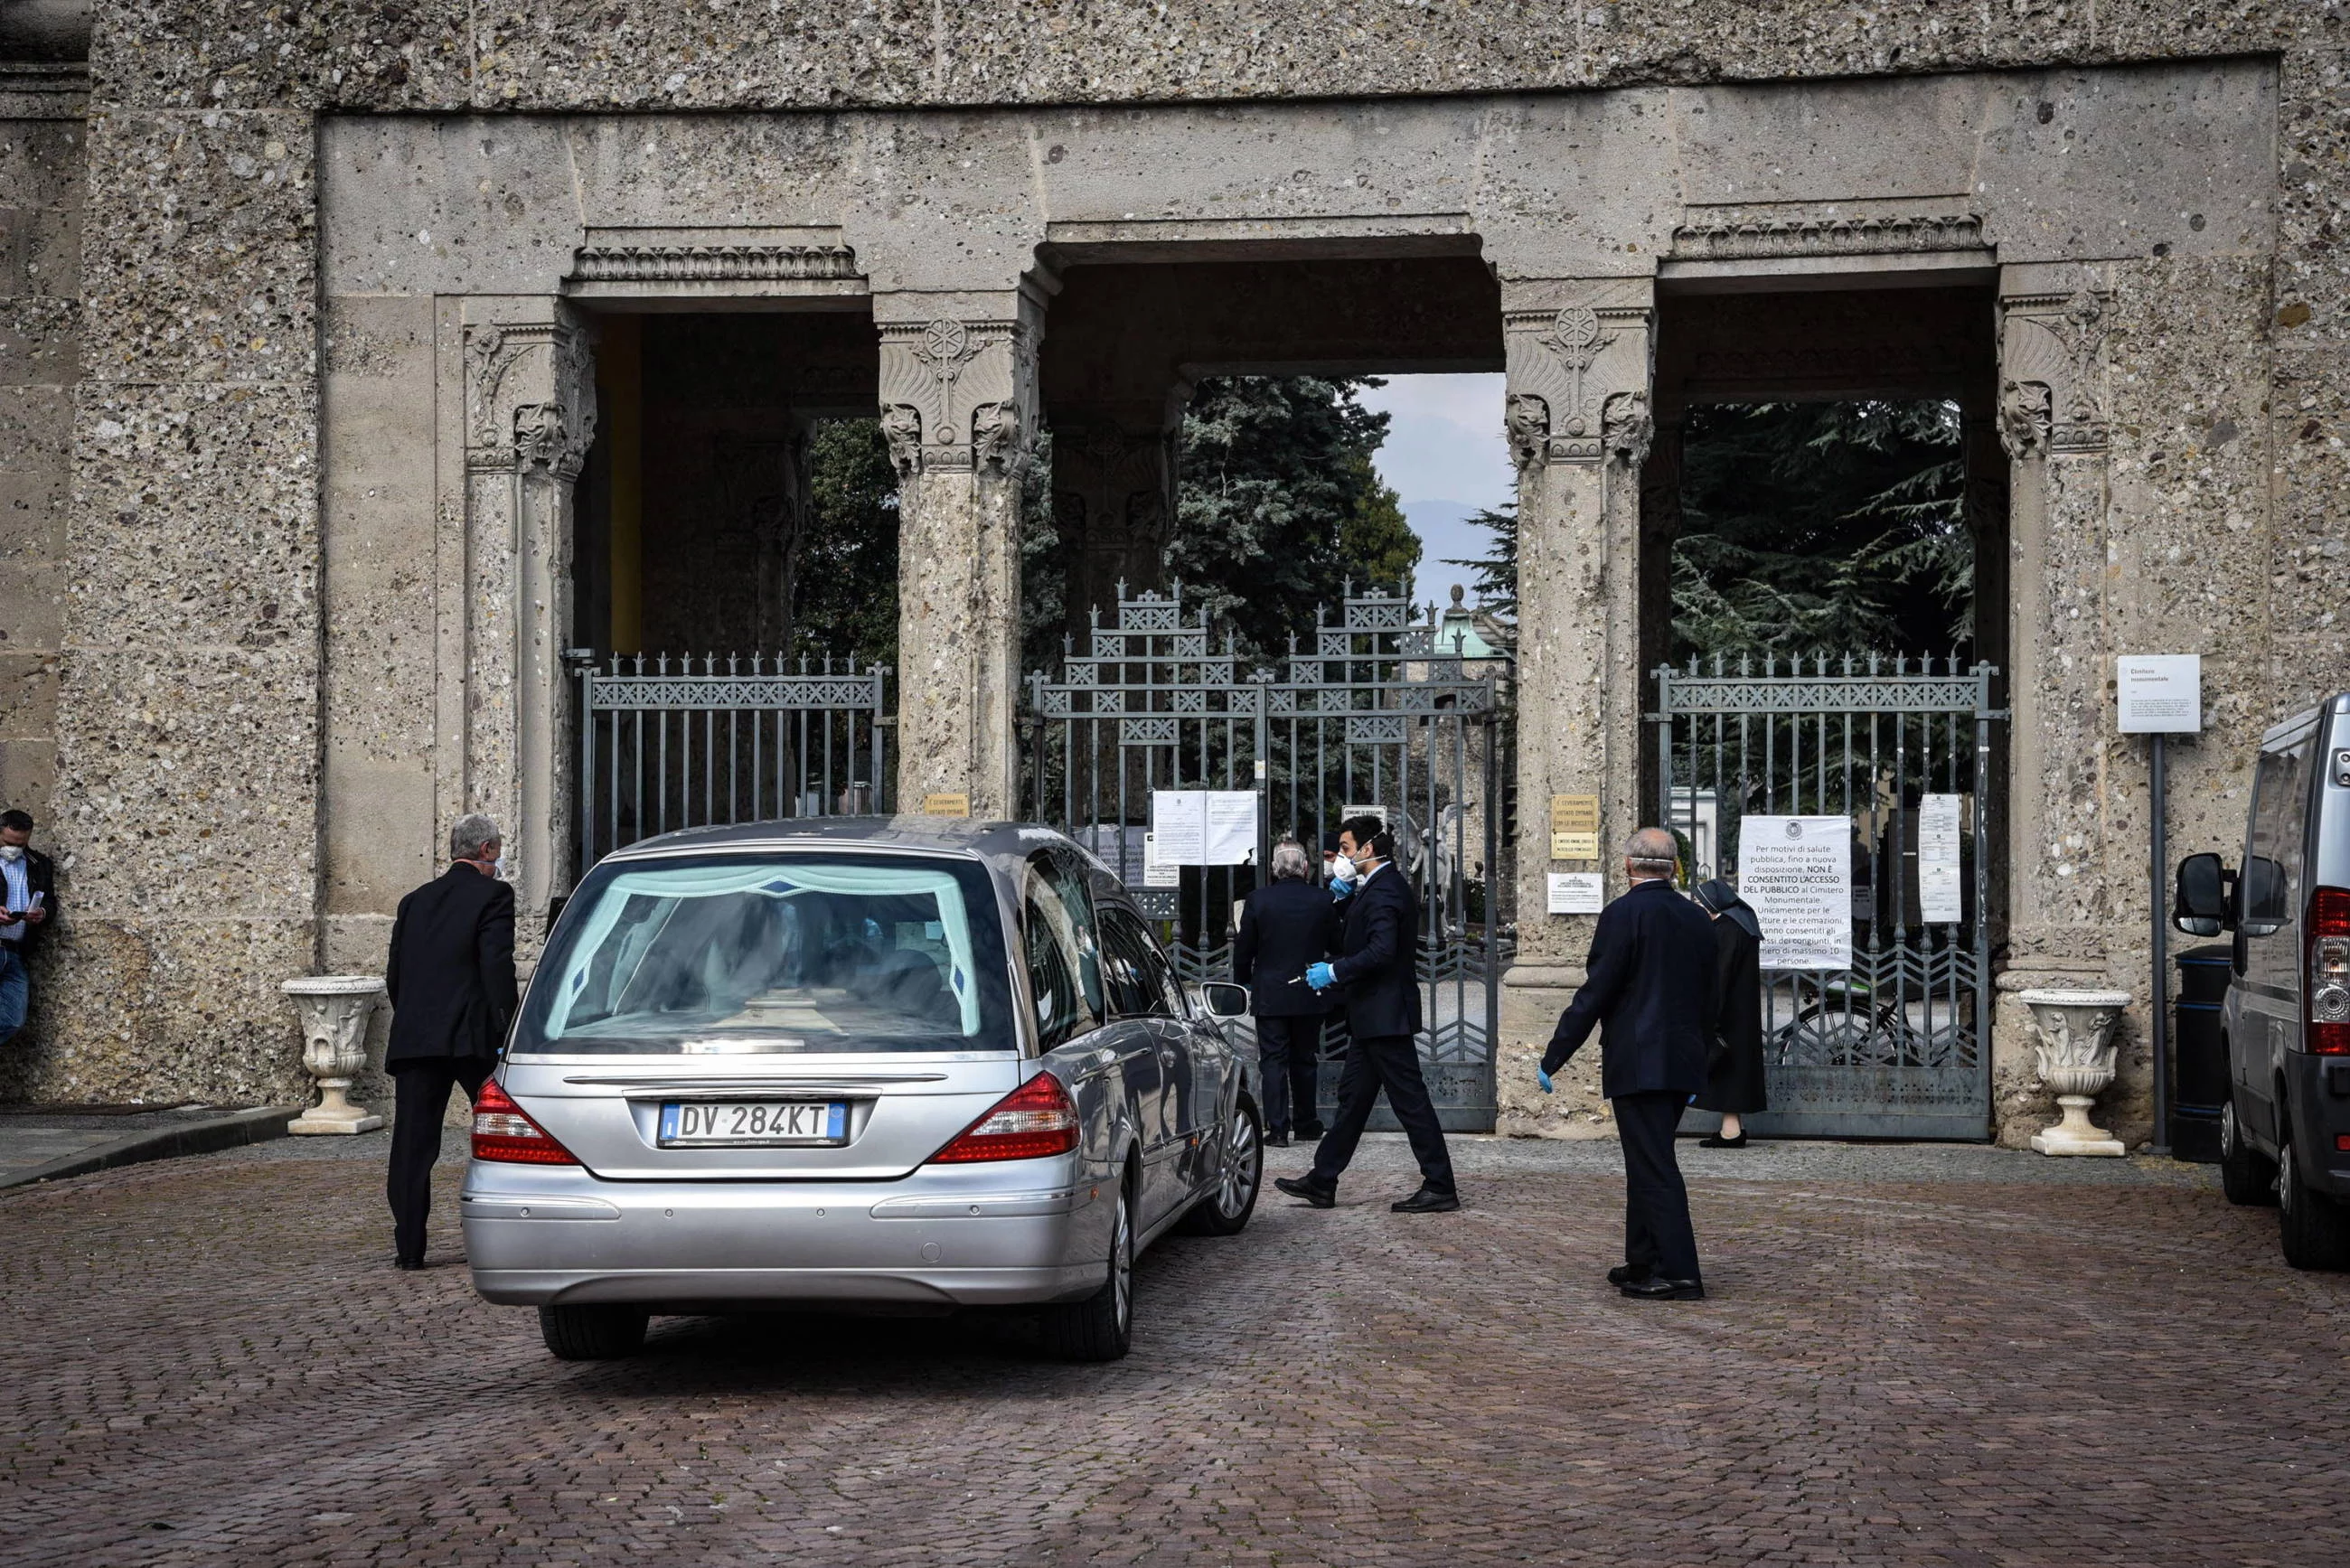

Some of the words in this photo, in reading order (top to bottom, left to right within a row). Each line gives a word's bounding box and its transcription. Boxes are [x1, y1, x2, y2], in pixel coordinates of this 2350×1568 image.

[1755, 845, 1768, 853] Per
[1772, 845, 1795, 853] motivi
[1798, 845, 1805, 853] di
[1807, 845, 1831, 853] salute
[1750, 855, 1786, 864] pubblica,
[1788, 855, 1803, 863] fino
[1754, 865, 1805, 874] disposizione,
[1828, 864, 1832, 873] È
[1747, 876, 1798, 884] CONSENTITO
[1800, 876, 1840, 884] L'ACCESSO
[1744, 886, 1758, 894] DEL
[1760, 886, 1799, 894] PUBBLICO
[1800, 886, 1808, 894] al
[1810, 886, 1844, 894] Cimitero
[1764, 896, 1823, 904] Monumentale.
[1757, 906, 1805, 915] Unicamente
[1807, 907, 1820, 915] per
[1757, 916, 1781, 925] olture
[1790, 916, 1797, 925] le
[1799, 916, 1845, 925] cremazioni,
[1785, 926, 1824, 934] consentiti
[1826, 926, 1836, 935] gli
[1792, 937, 1832, 946] congiunti,
[1782, 947, 1790, 955] di
[1792, 947, 1826, 955] massimo
[1829, 947, 1839, 955] 10
[682, 1106, 719, 1136] DV
[729, 1105, 826, 1136] 284KT
